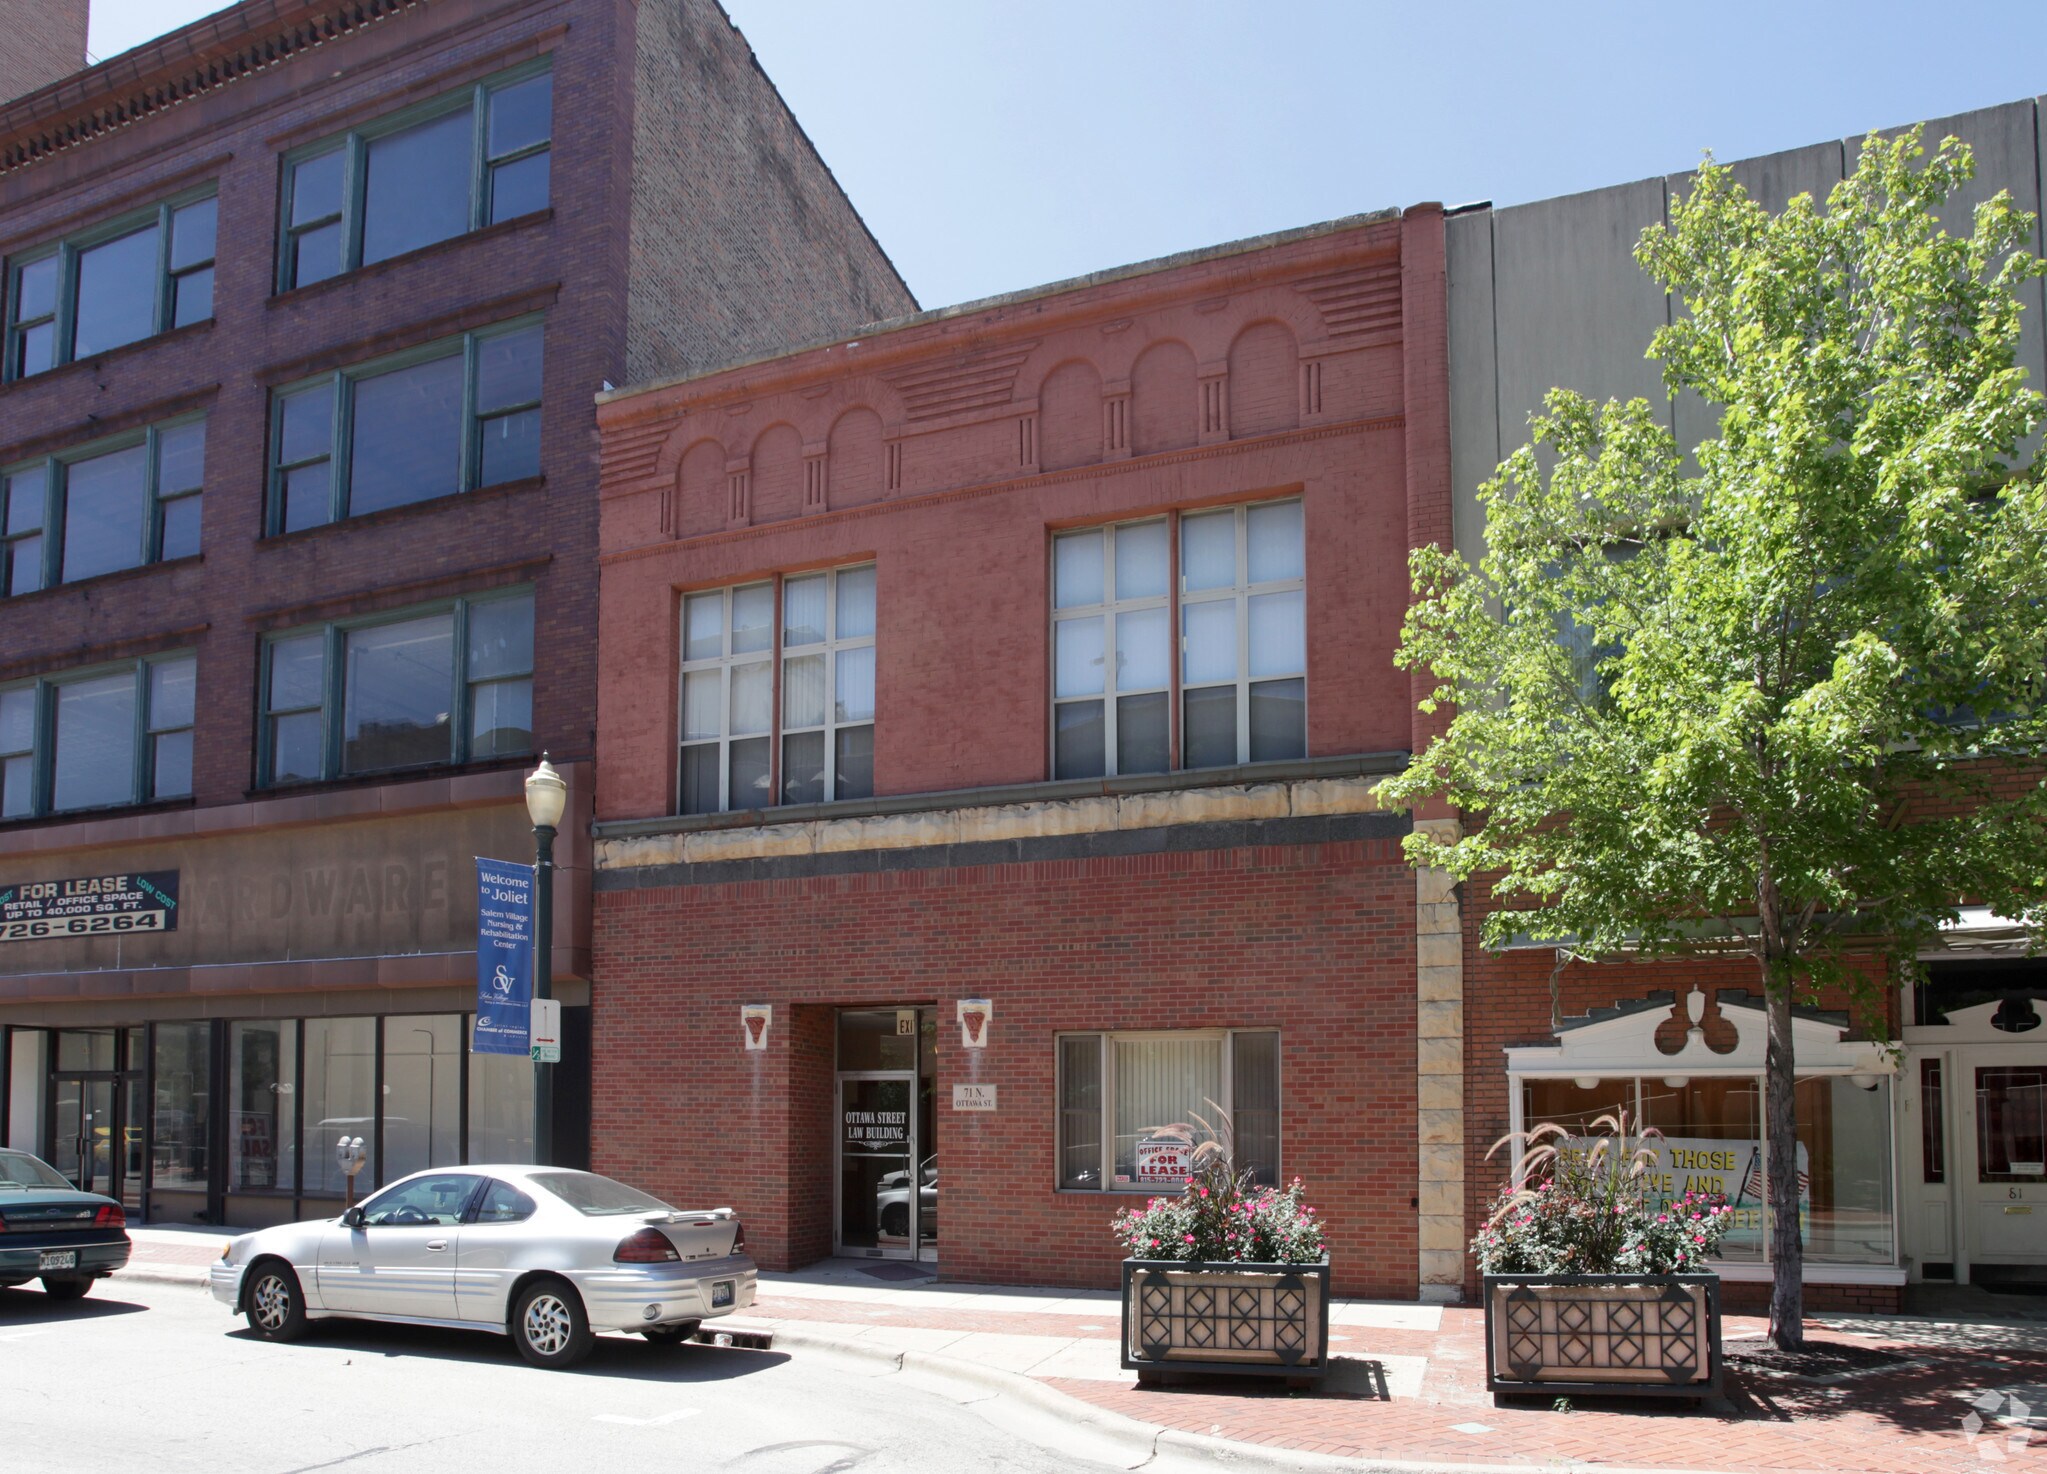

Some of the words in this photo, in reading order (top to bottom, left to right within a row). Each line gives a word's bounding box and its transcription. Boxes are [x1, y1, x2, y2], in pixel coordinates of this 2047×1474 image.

[481, 872, 529, 888] Welcome
[20, 882, 58, 900] FOR
[65, 876, 128, 896] LEASE
[136, 876, 155, 895] LOW
[154, 890, 177, 911] COST
[0, 889, 13, 905] OST
[4, 901, 42, 911] RETAIL
[57, 895, 98, 907] OFFICE
[103, 891, 144, 902] SPACE
[481, 886, 490, 895] to
[491, 888, 528, 905] Joliet
[6, 911, 23, 919] UP
[27, 909, 42, 918] TO
[47, 905, 91, 916] 40,000
[96, 903, 118, 911] SQ.
[123, 901, 142, 910] FT.
[481, 908, 504, 918] Salem
[505, 912, 528, 922] Village
[487, 919, 514, 931] Nursing
[481, 928, 528, 941] Rehabilitation
[493, 939, 516, 949] Center
[900, 1020, 914, 1034] EXI
[964, 1088, 973, 1097] 71
[975, 1088, 985, 1098] N.
[845, 1111, 875, 1124] OTTAWA
[877, 1111, 906, 1124] STREET
[848, 1127, 863, 1139] LAW
[866, 1127, 903, 1140] BUILDING
[1139, 1146, 1162, 1155] OFFICE
[1150, 1155, 1178, 1164] FOR
[1621, 1147, 1661, 1168] FR
[1670, 1148, 1736, 1171] THOSE
[1141, 1166, 1187, 1175] LEASE
[1684, 1175, 1725, 1195] AND
